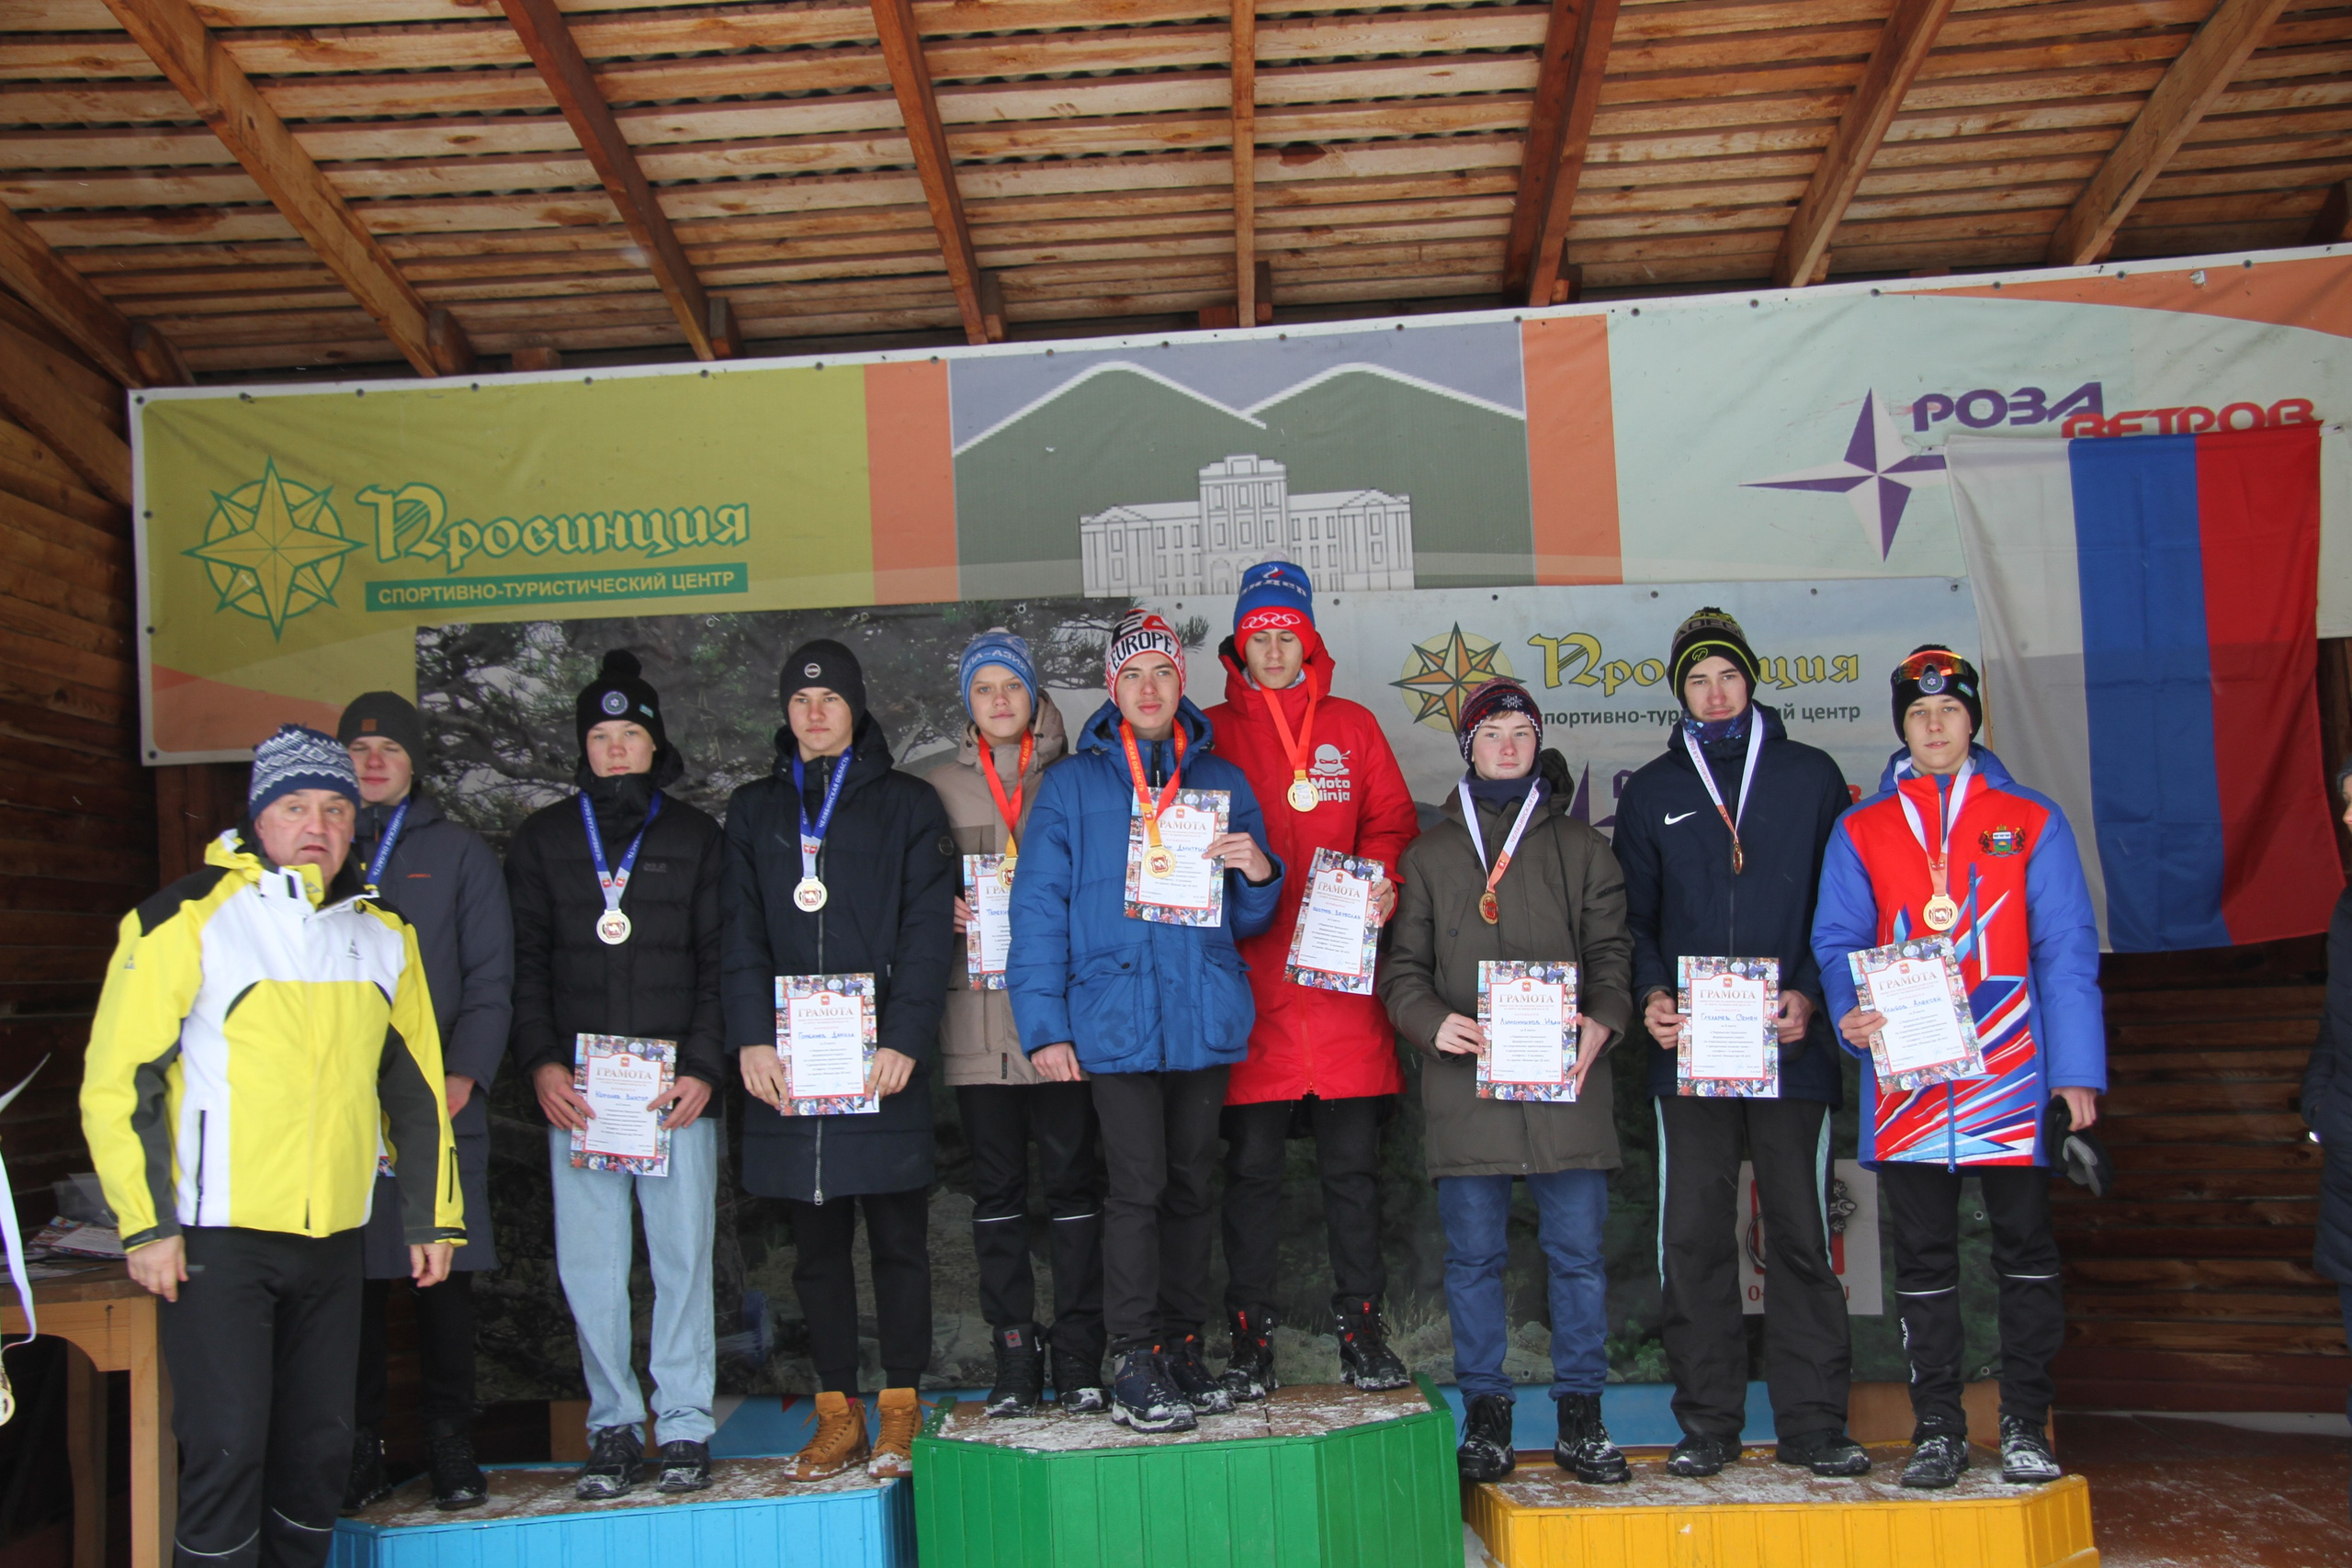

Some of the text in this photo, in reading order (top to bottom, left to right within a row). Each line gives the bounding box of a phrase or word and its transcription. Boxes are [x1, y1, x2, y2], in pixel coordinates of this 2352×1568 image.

[1913, 381, 2104, 433] РОЗА
[356, 482, 749, 574] Провинция
[378, 570, 734, 604] СПОРТИВНО-ТУРИСТИЧЕСКИЙ ЦЕНТР
[1111, 630, 1172, 671] EUROPE
[1802, 705, 1860, 723] центр
[1310, 777, 1351, 788] Moto
[1159, 819, 1206, 830] РАМОТА
[1317, 882, 1361, 898] ГРАМОТА
[1879, 971, 1938, 991] ГРАМОТА
[1498, 994, 1555, 1003] ГРАМОТА
[1700, 989, 1757, 999] ГРАМОТА
[798, 1007, 854, 1018] ГРАМОТА
[597, 1066, 652, 1080] ГРАМОТА
